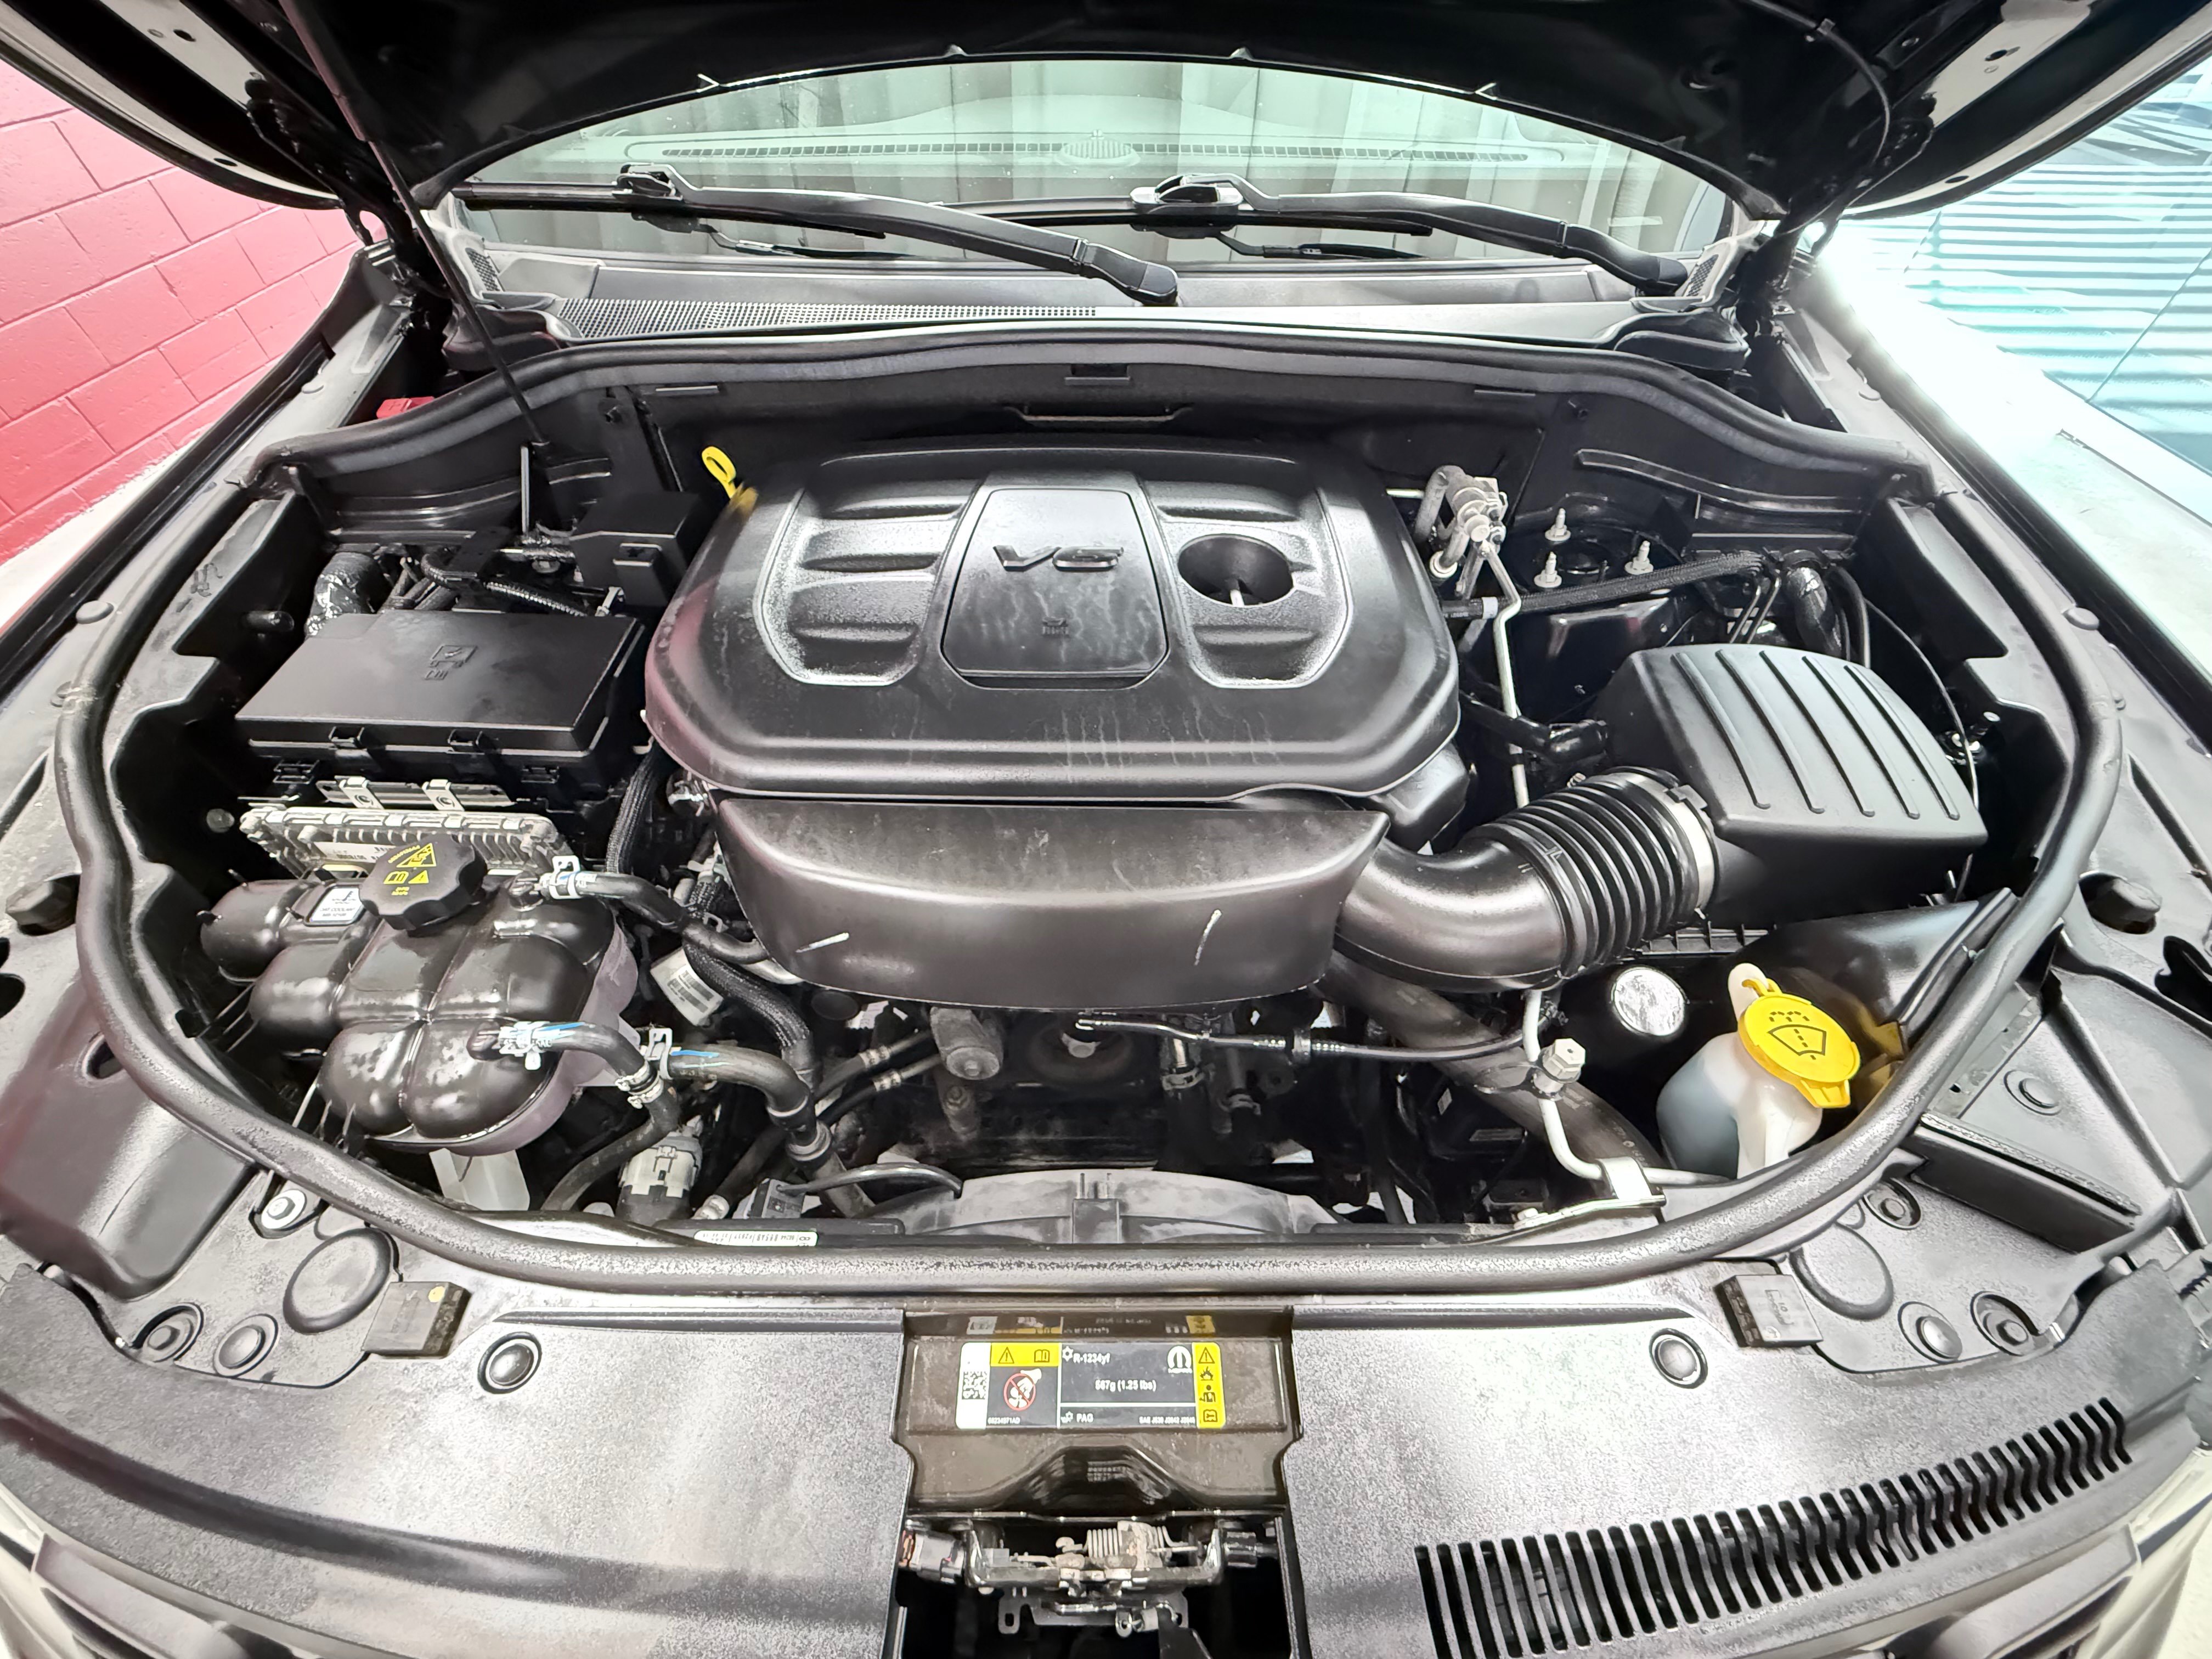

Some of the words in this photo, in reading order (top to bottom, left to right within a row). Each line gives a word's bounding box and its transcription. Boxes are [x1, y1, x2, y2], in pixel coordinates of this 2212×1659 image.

[992, 545, 1125, 572] V6
[1073, 1353, 1110, 1365] R-1234yf
[1095, 1379, 1116, 1392] 567g
[1118, 1379, 1138, 1392] (1.25
[1139, 1379, 1156, 1392] lbs)
[1076, 1413, 1094, 1423] PAG
